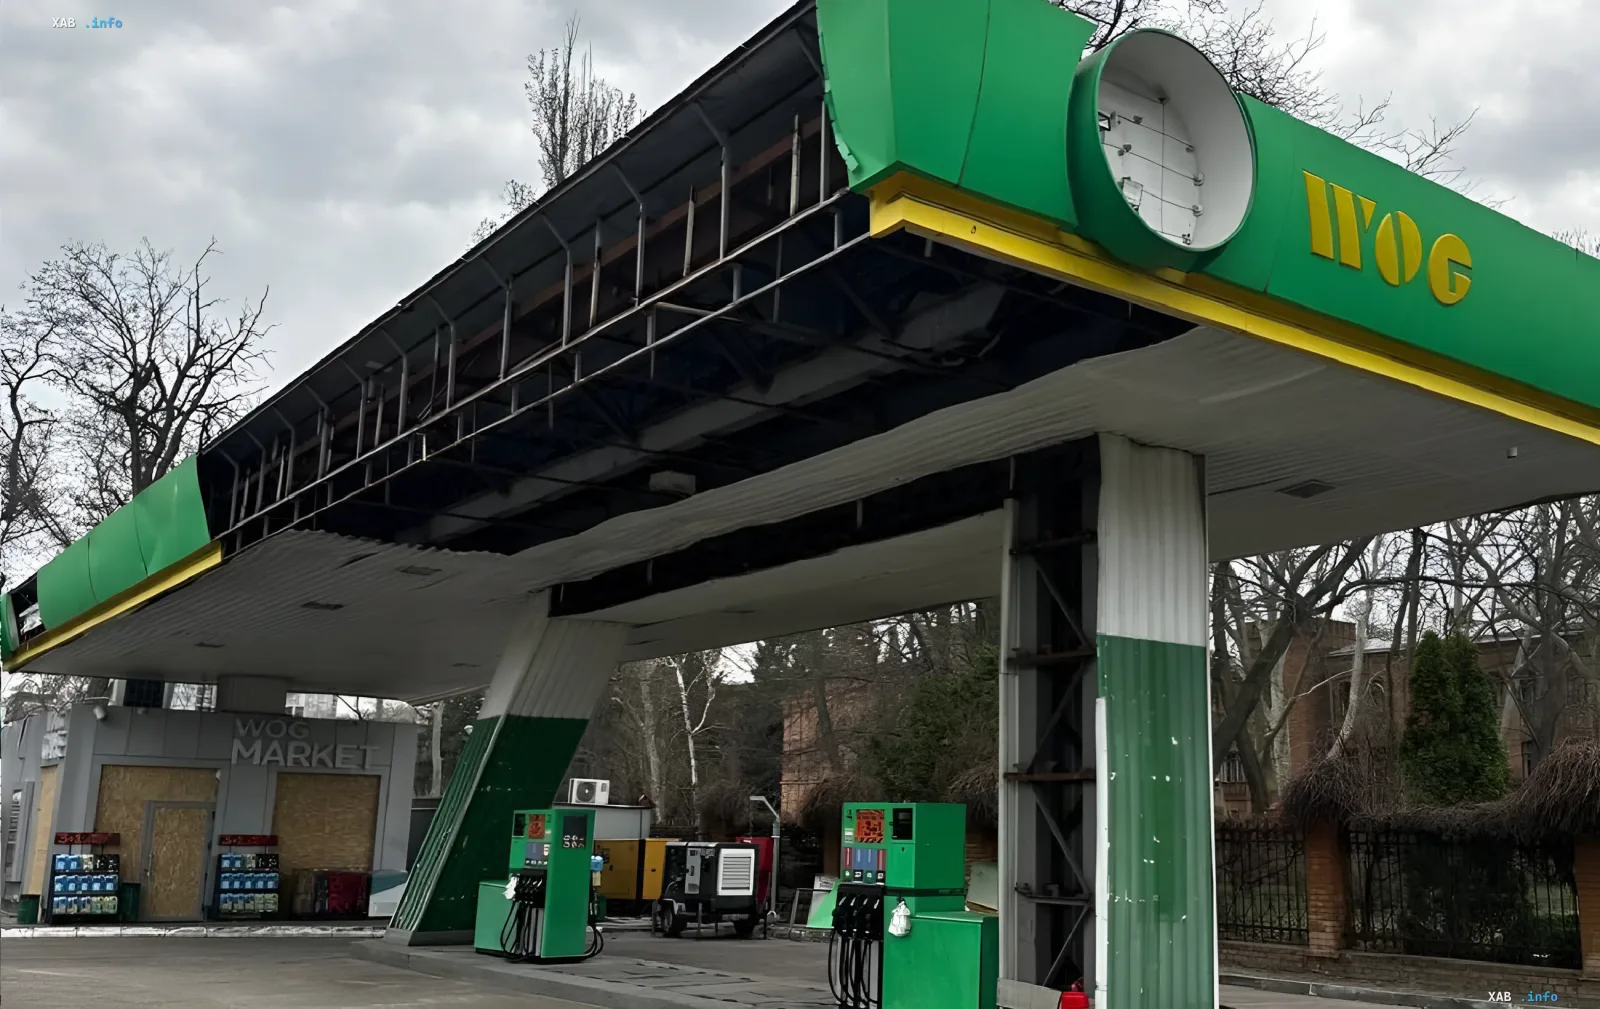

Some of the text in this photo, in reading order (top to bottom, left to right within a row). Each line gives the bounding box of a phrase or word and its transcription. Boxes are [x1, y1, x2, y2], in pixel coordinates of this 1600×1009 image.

[1303, 169, 1471, 305] WOG
[235, 717, 311, 740] WOG
[231, 738, 382, 770] MARKET
